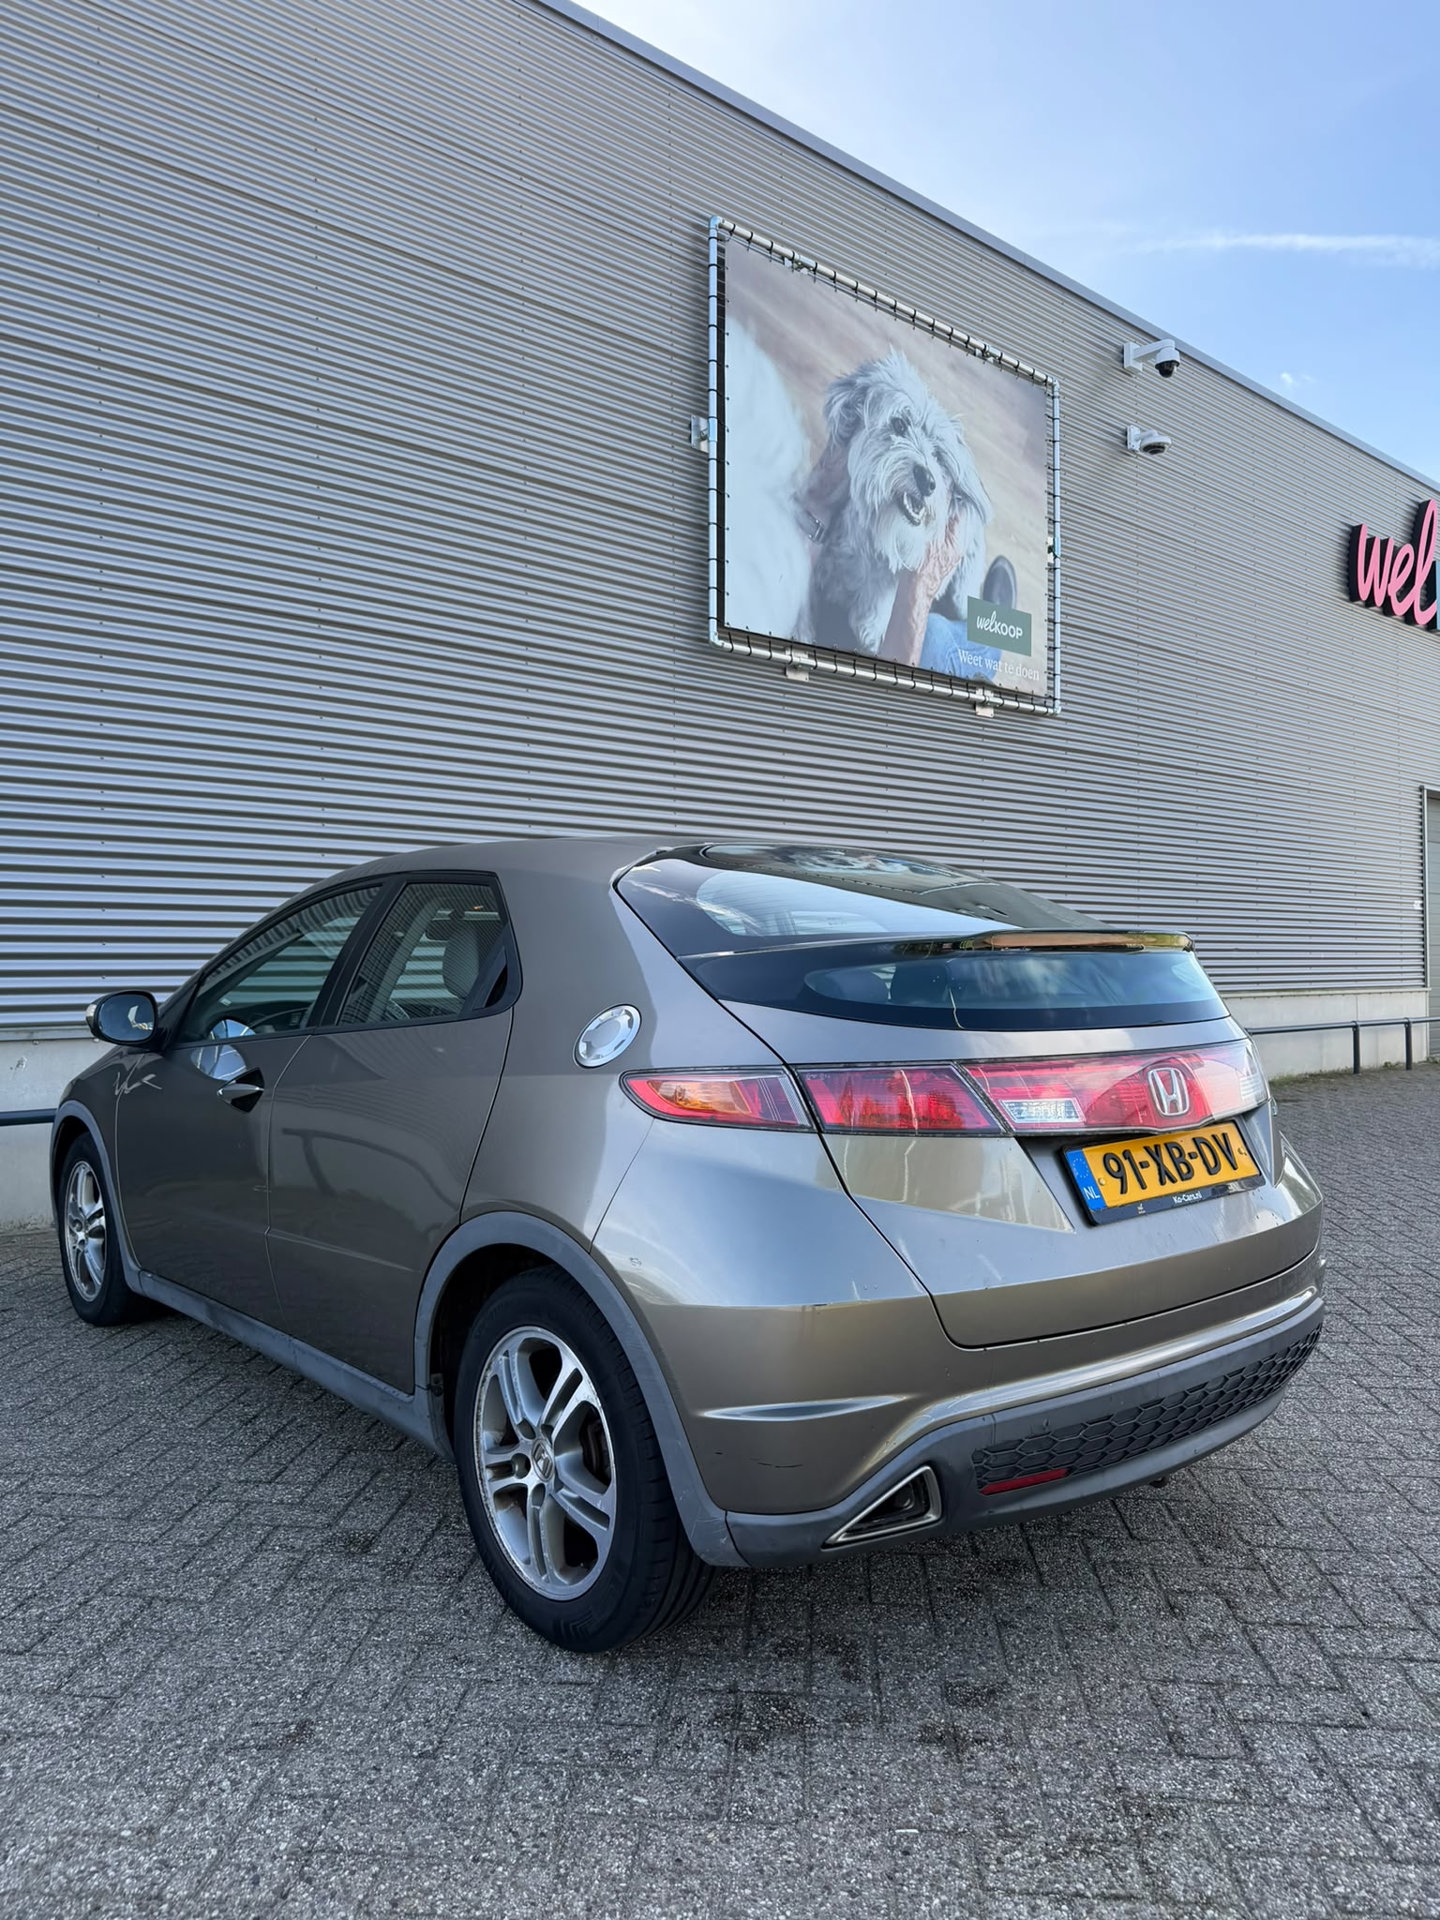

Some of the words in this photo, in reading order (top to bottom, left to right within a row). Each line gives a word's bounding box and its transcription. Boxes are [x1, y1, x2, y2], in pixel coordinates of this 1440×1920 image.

[958, 649, 983, 667] Weet
[984, 660, 1002, 672] wat
[1004, 662, 1015, 674] te
[1015, 664, 1040, 680] doen
[1102, 1132, 1239, 1195] 91-XB-DV
[1083, 1186, 1101, 1200] NL
